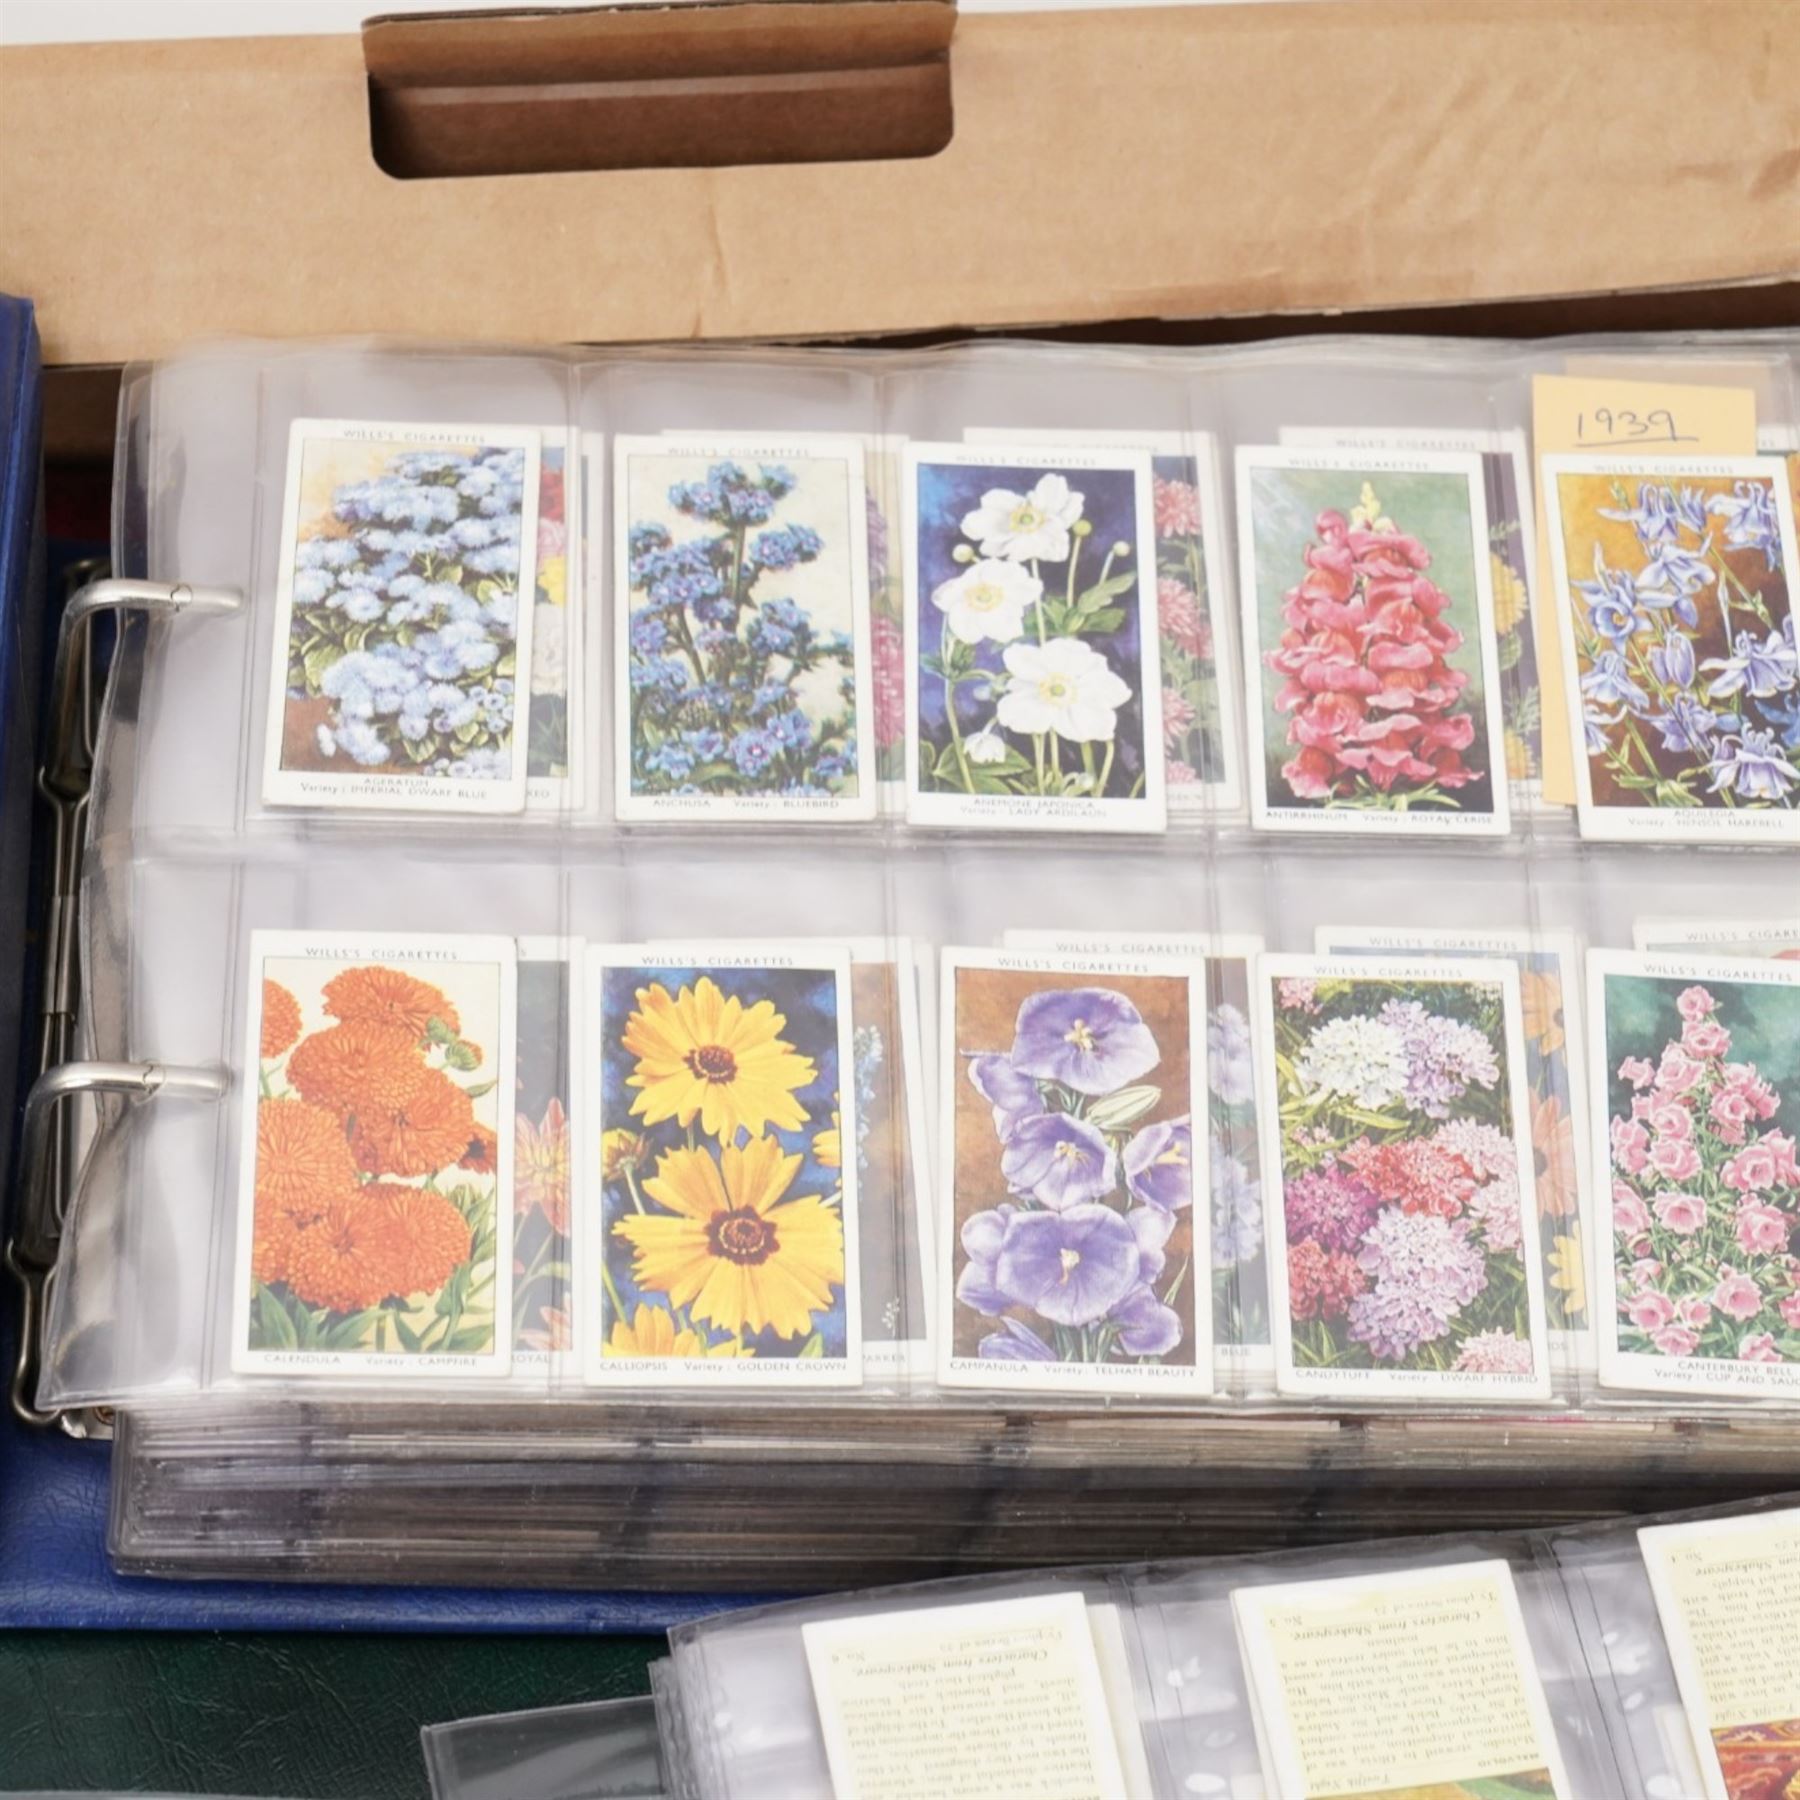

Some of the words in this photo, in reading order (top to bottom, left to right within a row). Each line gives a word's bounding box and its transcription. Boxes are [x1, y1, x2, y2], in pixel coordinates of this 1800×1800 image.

[1577, 407, 1680, 442] 1939
[300, 782, 339, 795] Variety
[351, 785, 403, 796] IMPERIAL
[458, 789, 487, 800] BLUE
[371, 949, 458, 960] CIGARETTES
[1121, 943, 1205, 954] CIGARETTES
[641, 956, 697, 966] WILLS'S
[707, 956, 793, 966] CIGARETTES
[998, 957, 1052, 969] WILLS'S
[1062, 961, 1148, 973] CIGARETTES
[1378, 967, 1463, 978] CIGARETTES
[1644, 964, 1697, 976] WILLS'S
[1707, 968, 1793, 981] CIGARETTES
[264, 1354, 341, 1365] CALENDULA
[366, 1356, 404, 1368] Variety
[600, 1361, 668, 1372] CALLIOPSIS
[684, 1362, 723, 1374] Variety
[736, 1361, 790, 1372] GOLDEN
[795, 1361, 847, 1372] CROWN
[950, 1361, 1028, 1373] CAMPANULA
[1044, 1364, 1084, 1376] Variety
[1147, 1367, 1196, 1378] BEAUTY
[1677, 1361, 1759, 1374] CANTERBURY
[1766, 1365, 1792, 1376] BELL
[1389, 1372, 1428, 1384] Variety
[1654, 1369, 1693, 1382] Variety
[1706, 1372, 1731, 1383] CUP
[1737, 1374, 1765, 1385] AND
